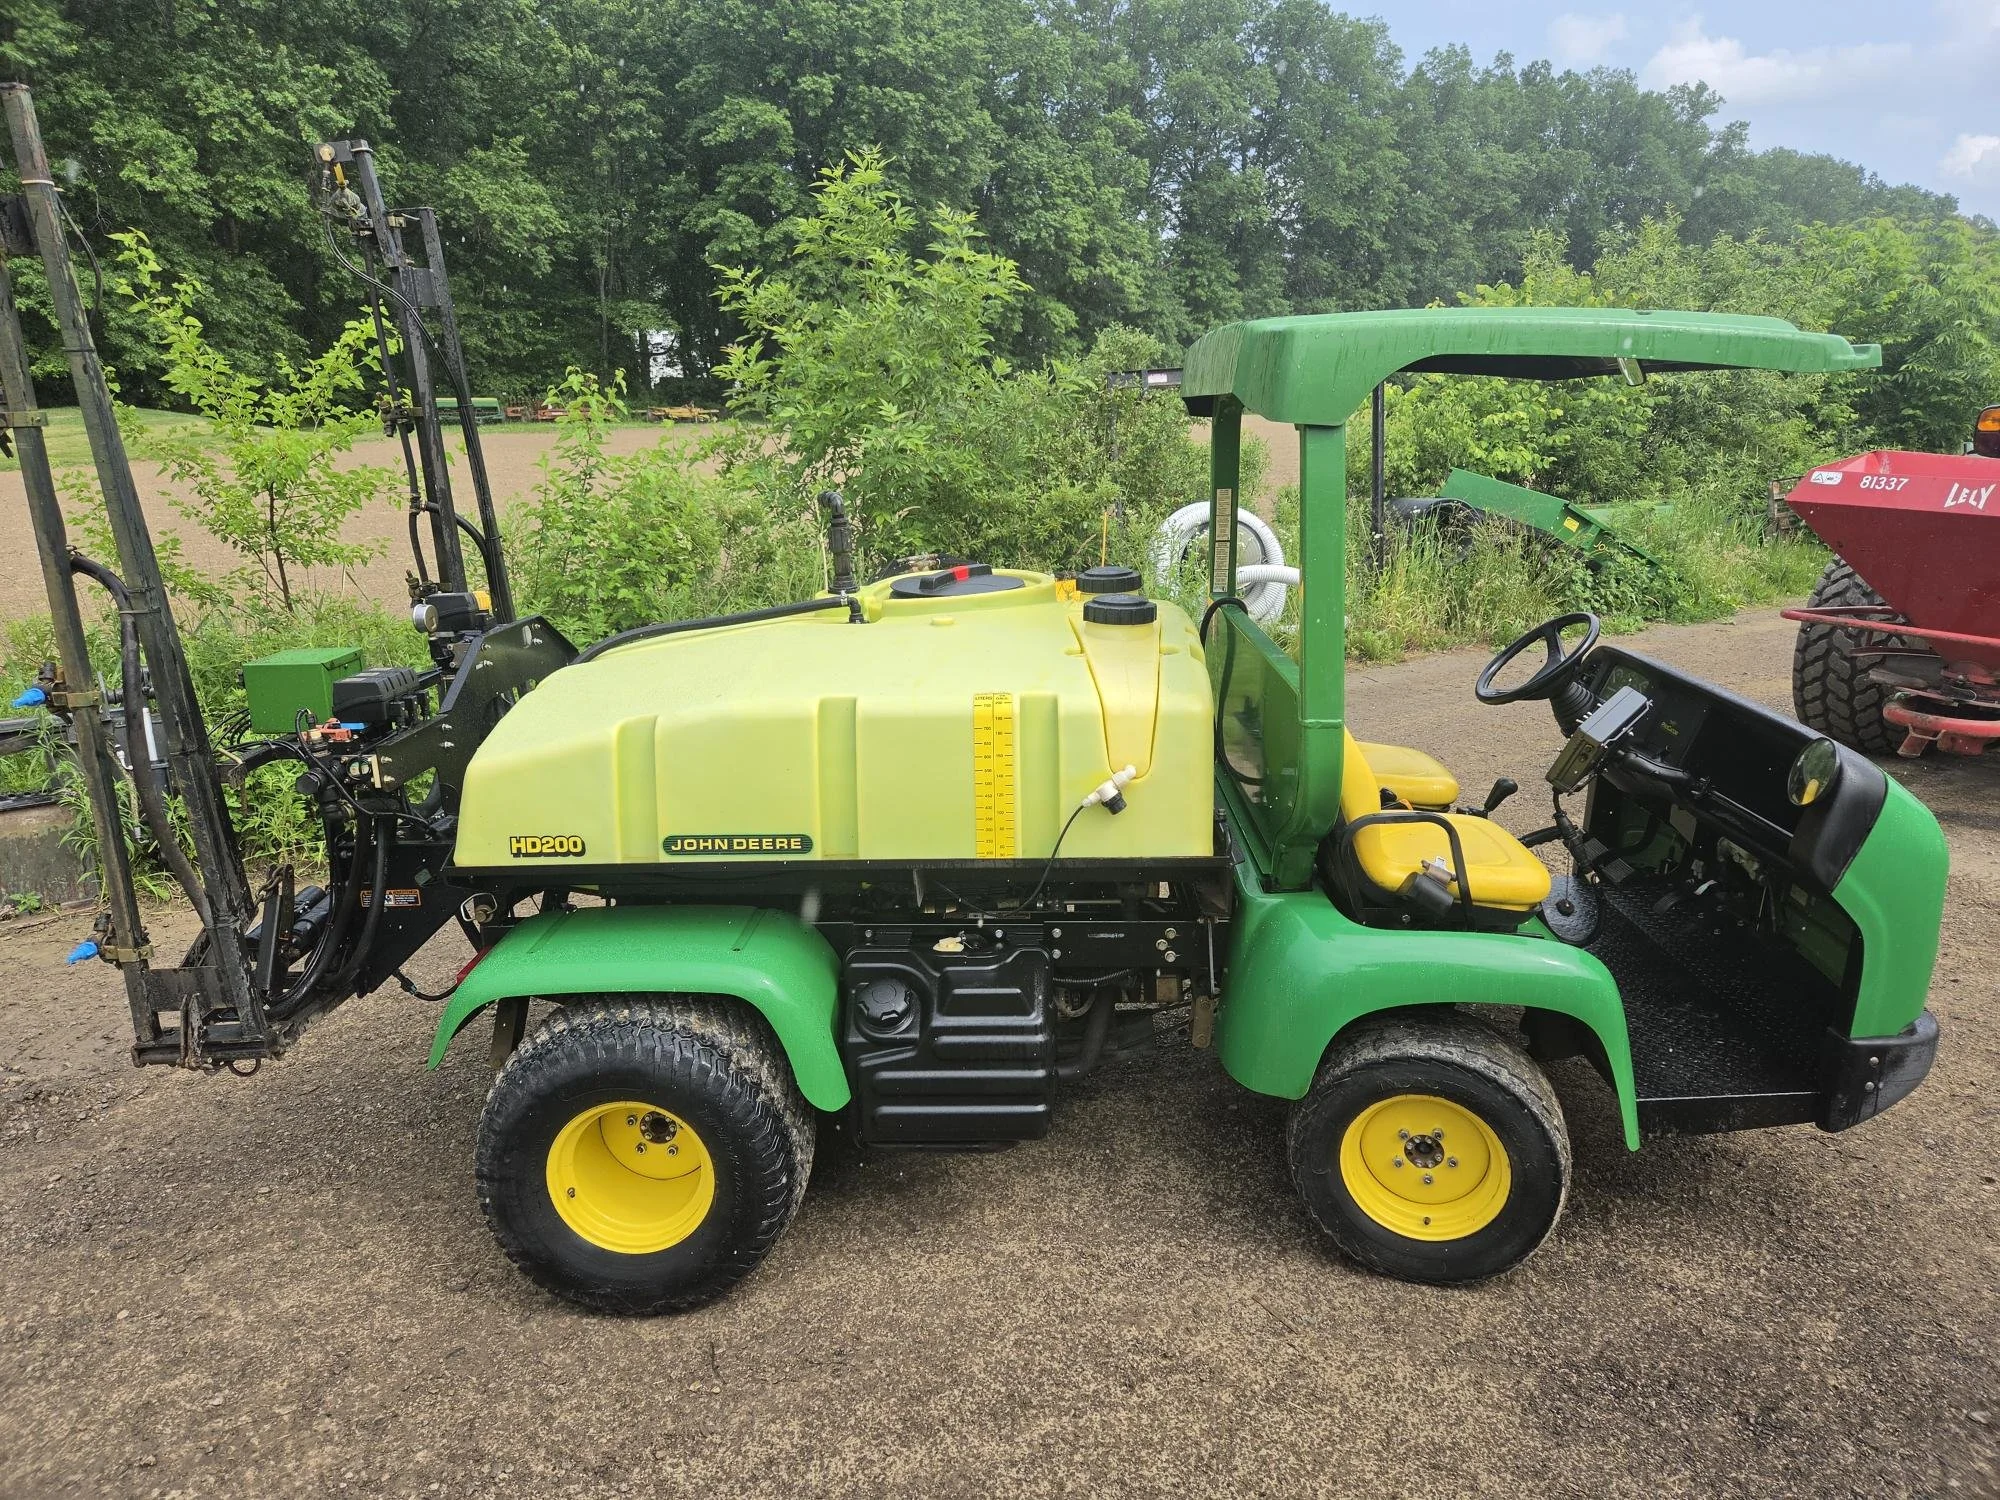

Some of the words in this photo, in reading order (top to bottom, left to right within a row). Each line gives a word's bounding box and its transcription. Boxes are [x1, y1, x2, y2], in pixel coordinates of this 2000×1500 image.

[1860, 475, 1909, 491] 81337
[1943, 482, 1996, 510] LELY
[510, 836, 585, 856] HD200
[671, 838, 728, 851] JOHN
[733, 837, 802, 850] DEERE
